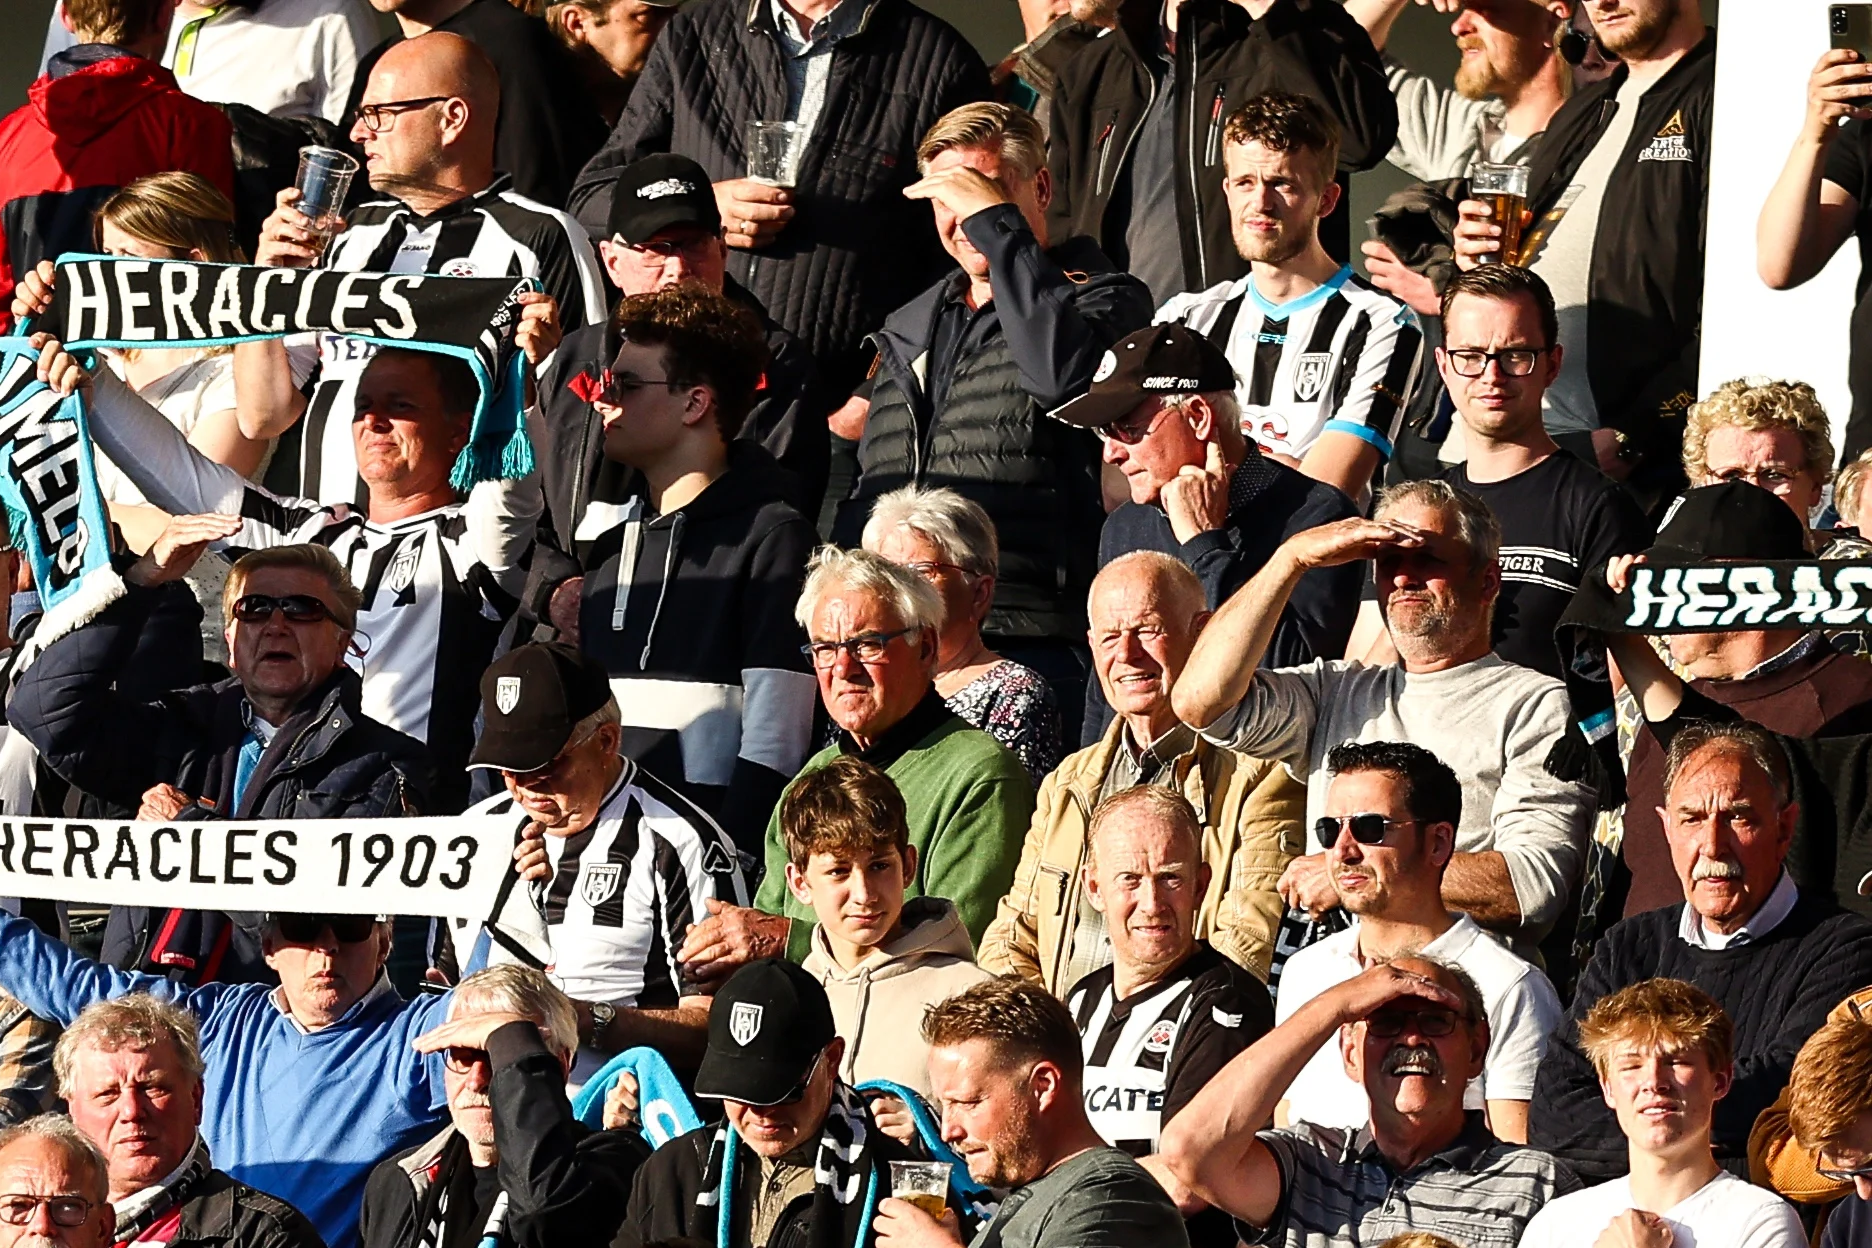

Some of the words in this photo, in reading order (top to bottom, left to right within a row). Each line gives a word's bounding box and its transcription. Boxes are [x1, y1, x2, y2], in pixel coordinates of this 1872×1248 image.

[65, 261, 419, 341] HERACLES
[1142, 377, 1178, 389] SINCE
[1178, 379, 1199, 389] 1903
[328, 830, 481, 889] 1903
[1085, 1085, 1165, 1113] CATE
